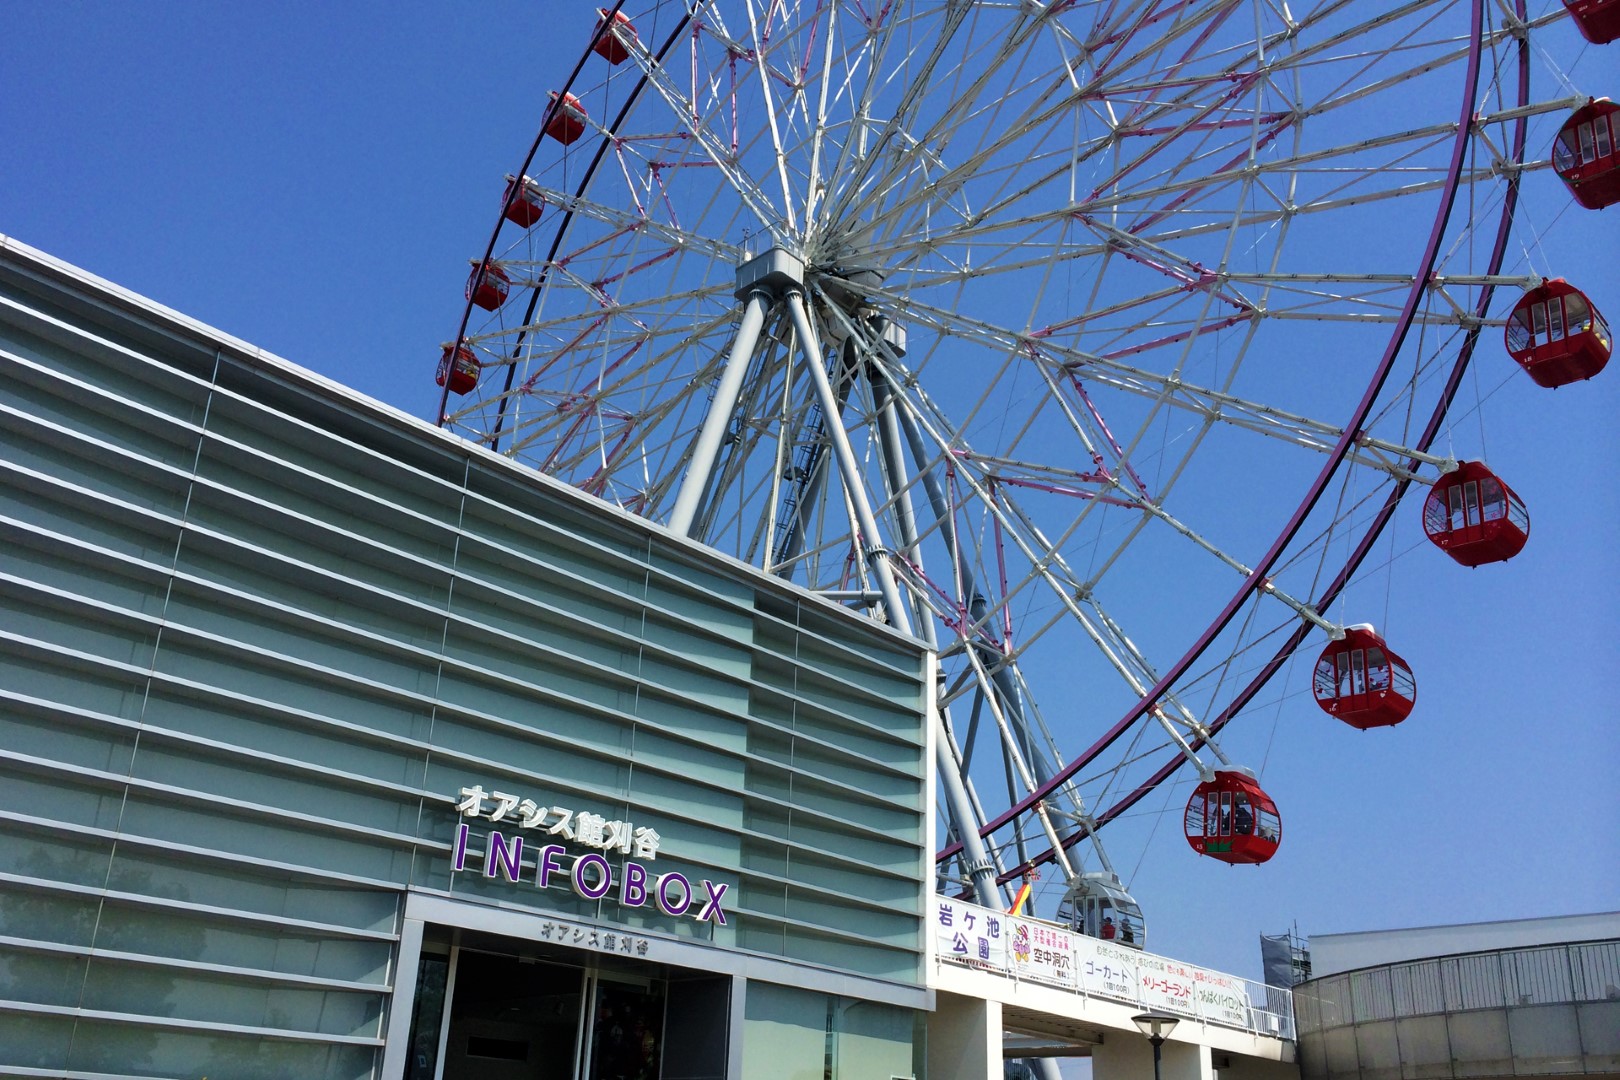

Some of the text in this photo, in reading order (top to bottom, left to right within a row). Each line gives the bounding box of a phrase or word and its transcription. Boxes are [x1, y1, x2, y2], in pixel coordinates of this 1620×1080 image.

[455, 784, 661, 861] オアシス館刈谷
[450, 823, 730, 926] INFOBOX
[540, 921, 650, 956] オアシス館刈谷
[952, 931, 990, 960] 公園
[1033, 948, 1071, 970] 空中洞穴
[1086, 961, 1128, 983] ゴーカート
[1142, 975, 1192, 999] メリーゴーランド
